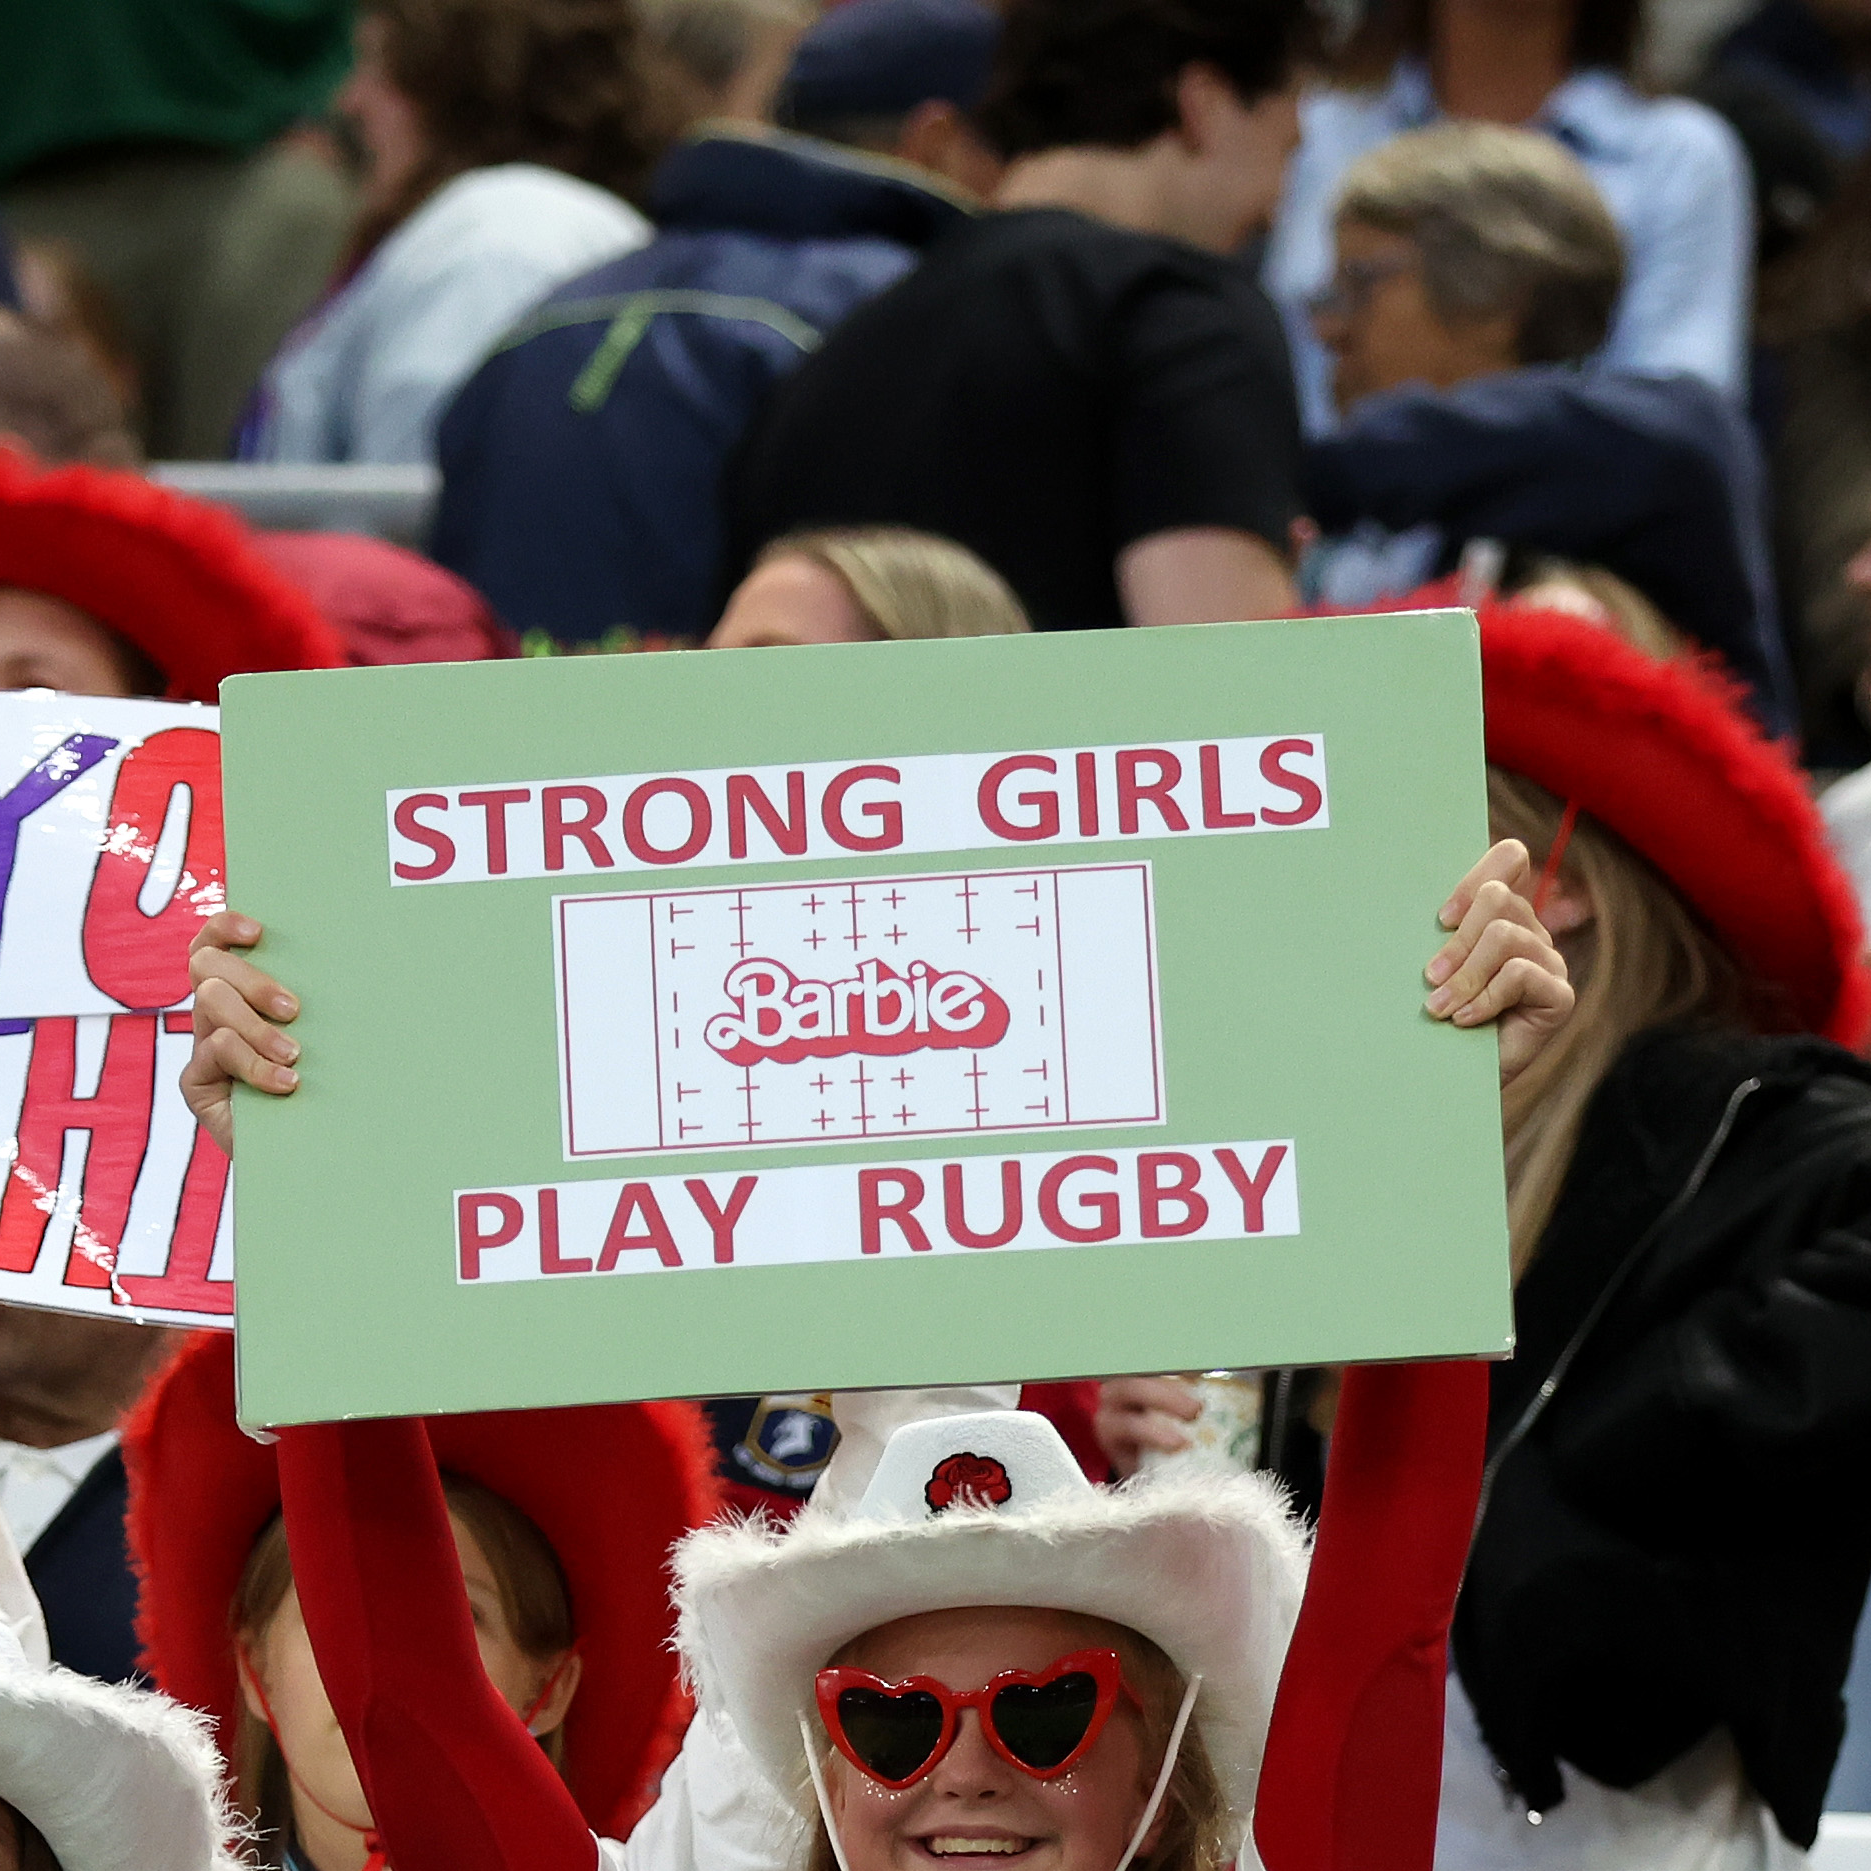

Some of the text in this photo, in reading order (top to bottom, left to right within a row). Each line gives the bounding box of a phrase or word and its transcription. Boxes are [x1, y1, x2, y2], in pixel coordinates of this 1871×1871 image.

[392, 738, 1324, 882] STRONG GIRLS
[705, 957, 1003, 1063] Barbie
[457, 1145, 1289, 1281] PLAY RUGBY
